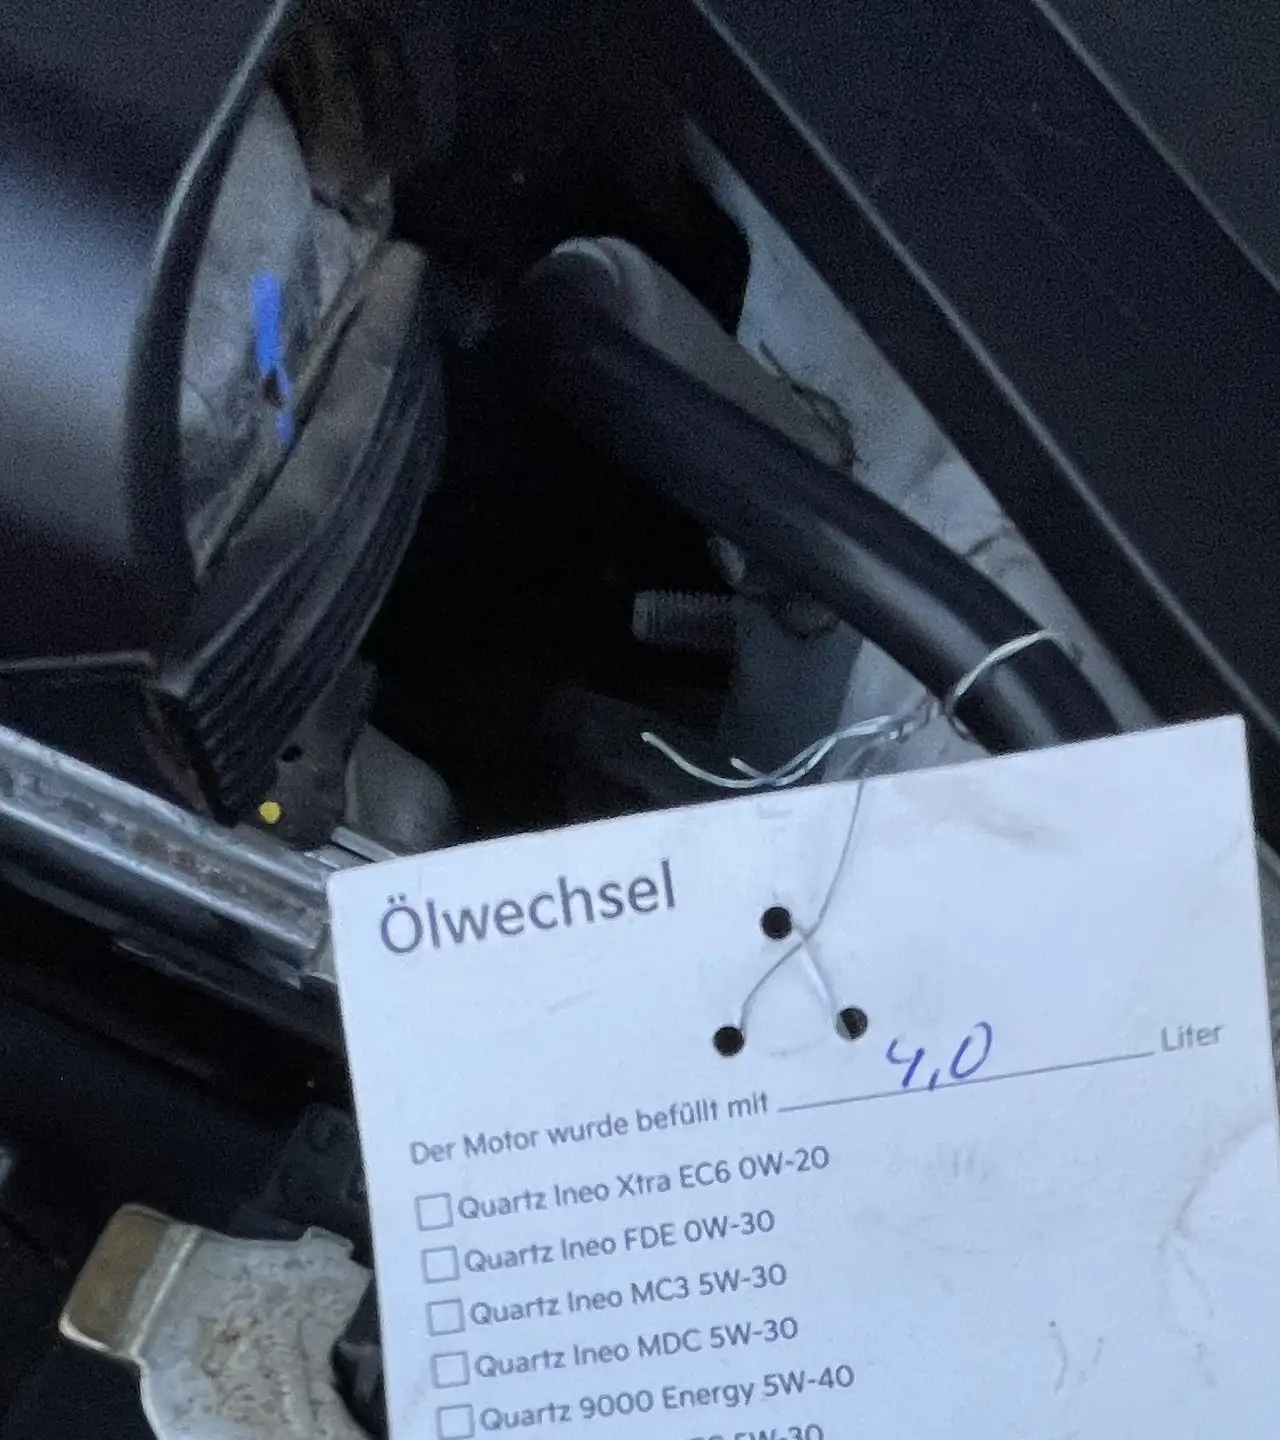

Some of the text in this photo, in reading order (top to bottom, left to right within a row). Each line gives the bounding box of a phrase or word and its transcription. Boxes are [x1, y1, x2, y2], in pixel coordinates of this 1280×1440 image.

[381, 860, 677, 954] Ölwechsel
[886, 1021, 993, 1090] 4,0
[1161, 1023, 1222, 1052] Liter
[411, 1091, 769, 1165] Der Motor wurde befüllt mit
[457, 1145, 830, 1220] Quartz Ineo Xtra EC6 0W-20
[464, 1209, 775, 1273] Quartz Ineo FDE 0W-30
[469, 1263, 787, 1326] Quartz Ineo MC3 5W-30
[475, 1316, 798, 1378] Quartz Ineo MDC 5W-30
[480, 1364, 855, 1432] Quartz 9000 Energy 5W-40
